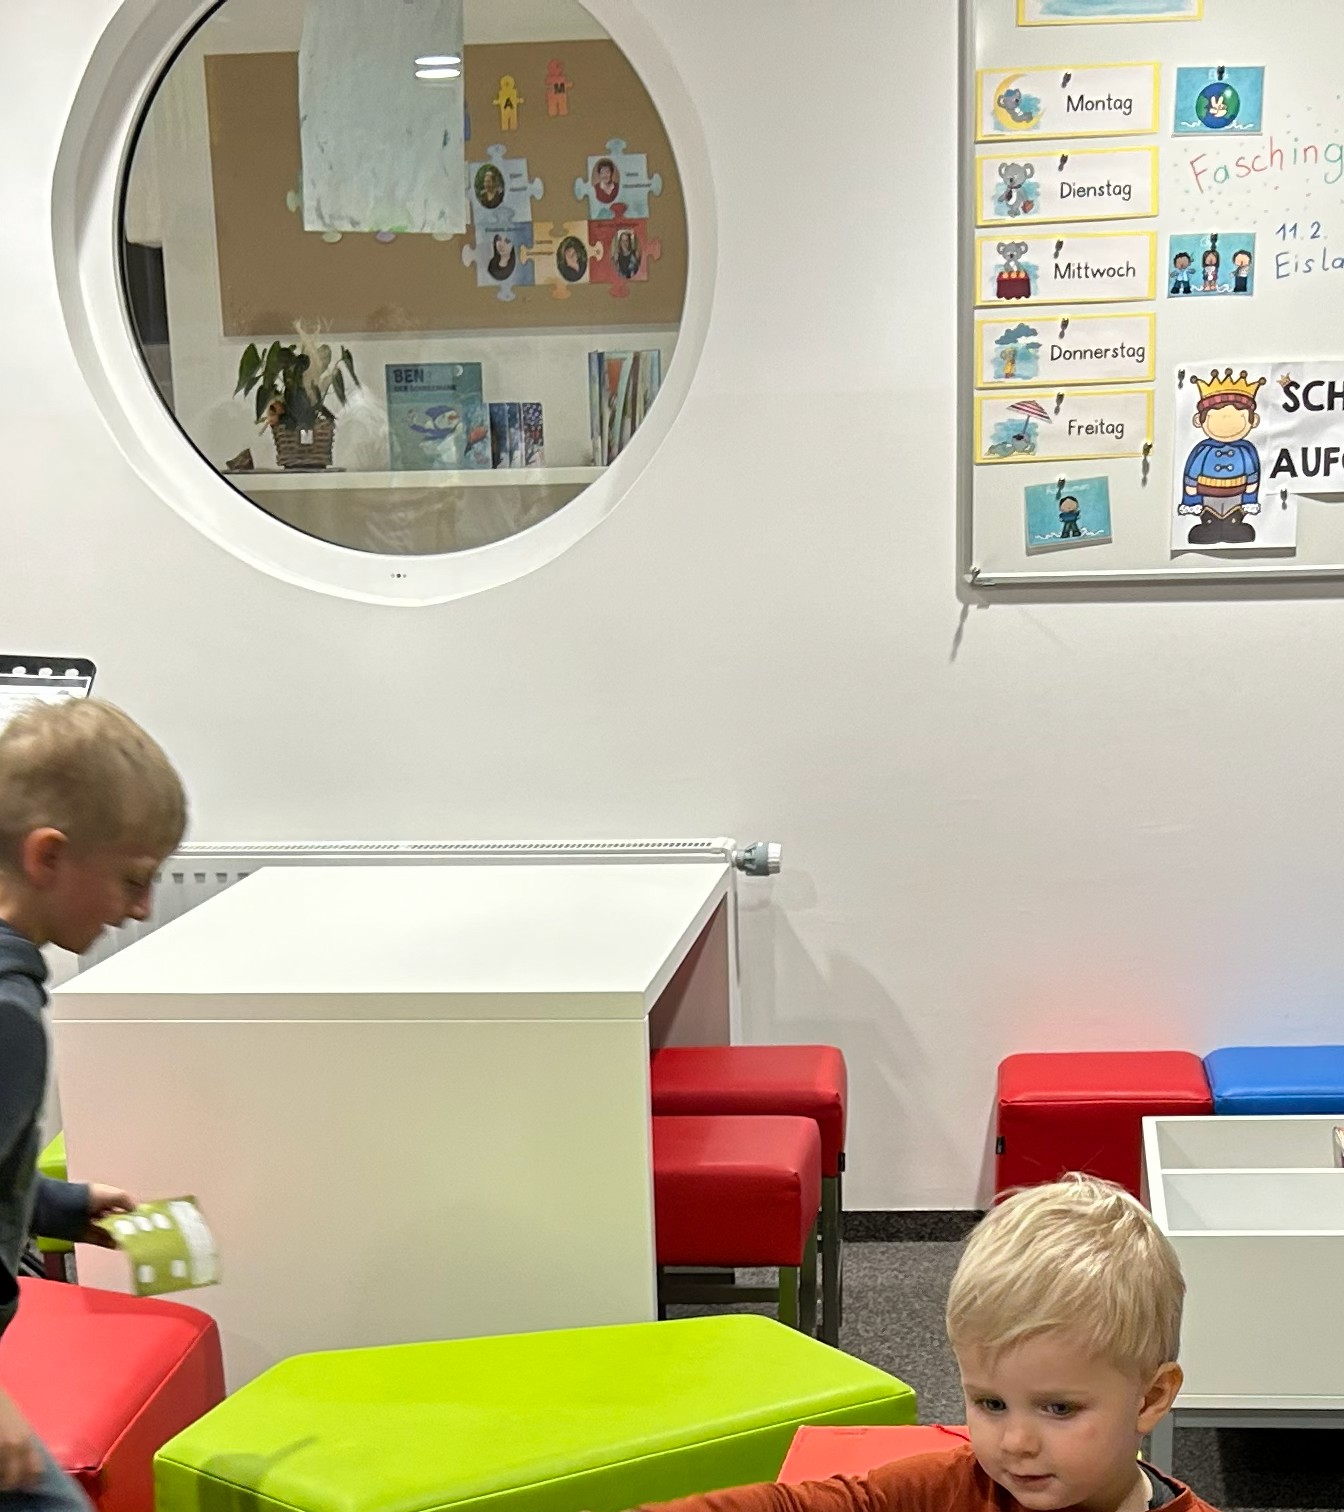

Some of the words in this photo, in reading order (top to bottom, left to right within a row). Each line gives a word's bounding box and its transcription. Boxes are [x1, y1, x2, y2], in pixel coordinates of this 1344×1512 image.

[503, 97, 514, 109] A
[1066, 93, 1133, 116] Montag
[1189, 135, 1344, 194] Fasching
[1059, 179, 1132, 201] Dienstag
[1053, 260, 1136, 280] Mittwoch
[1050, 341, 1146, 363] Donnerstag
[393, 368, 424, 383] BEN
[1067, 418, 1125, 440] Freitag
